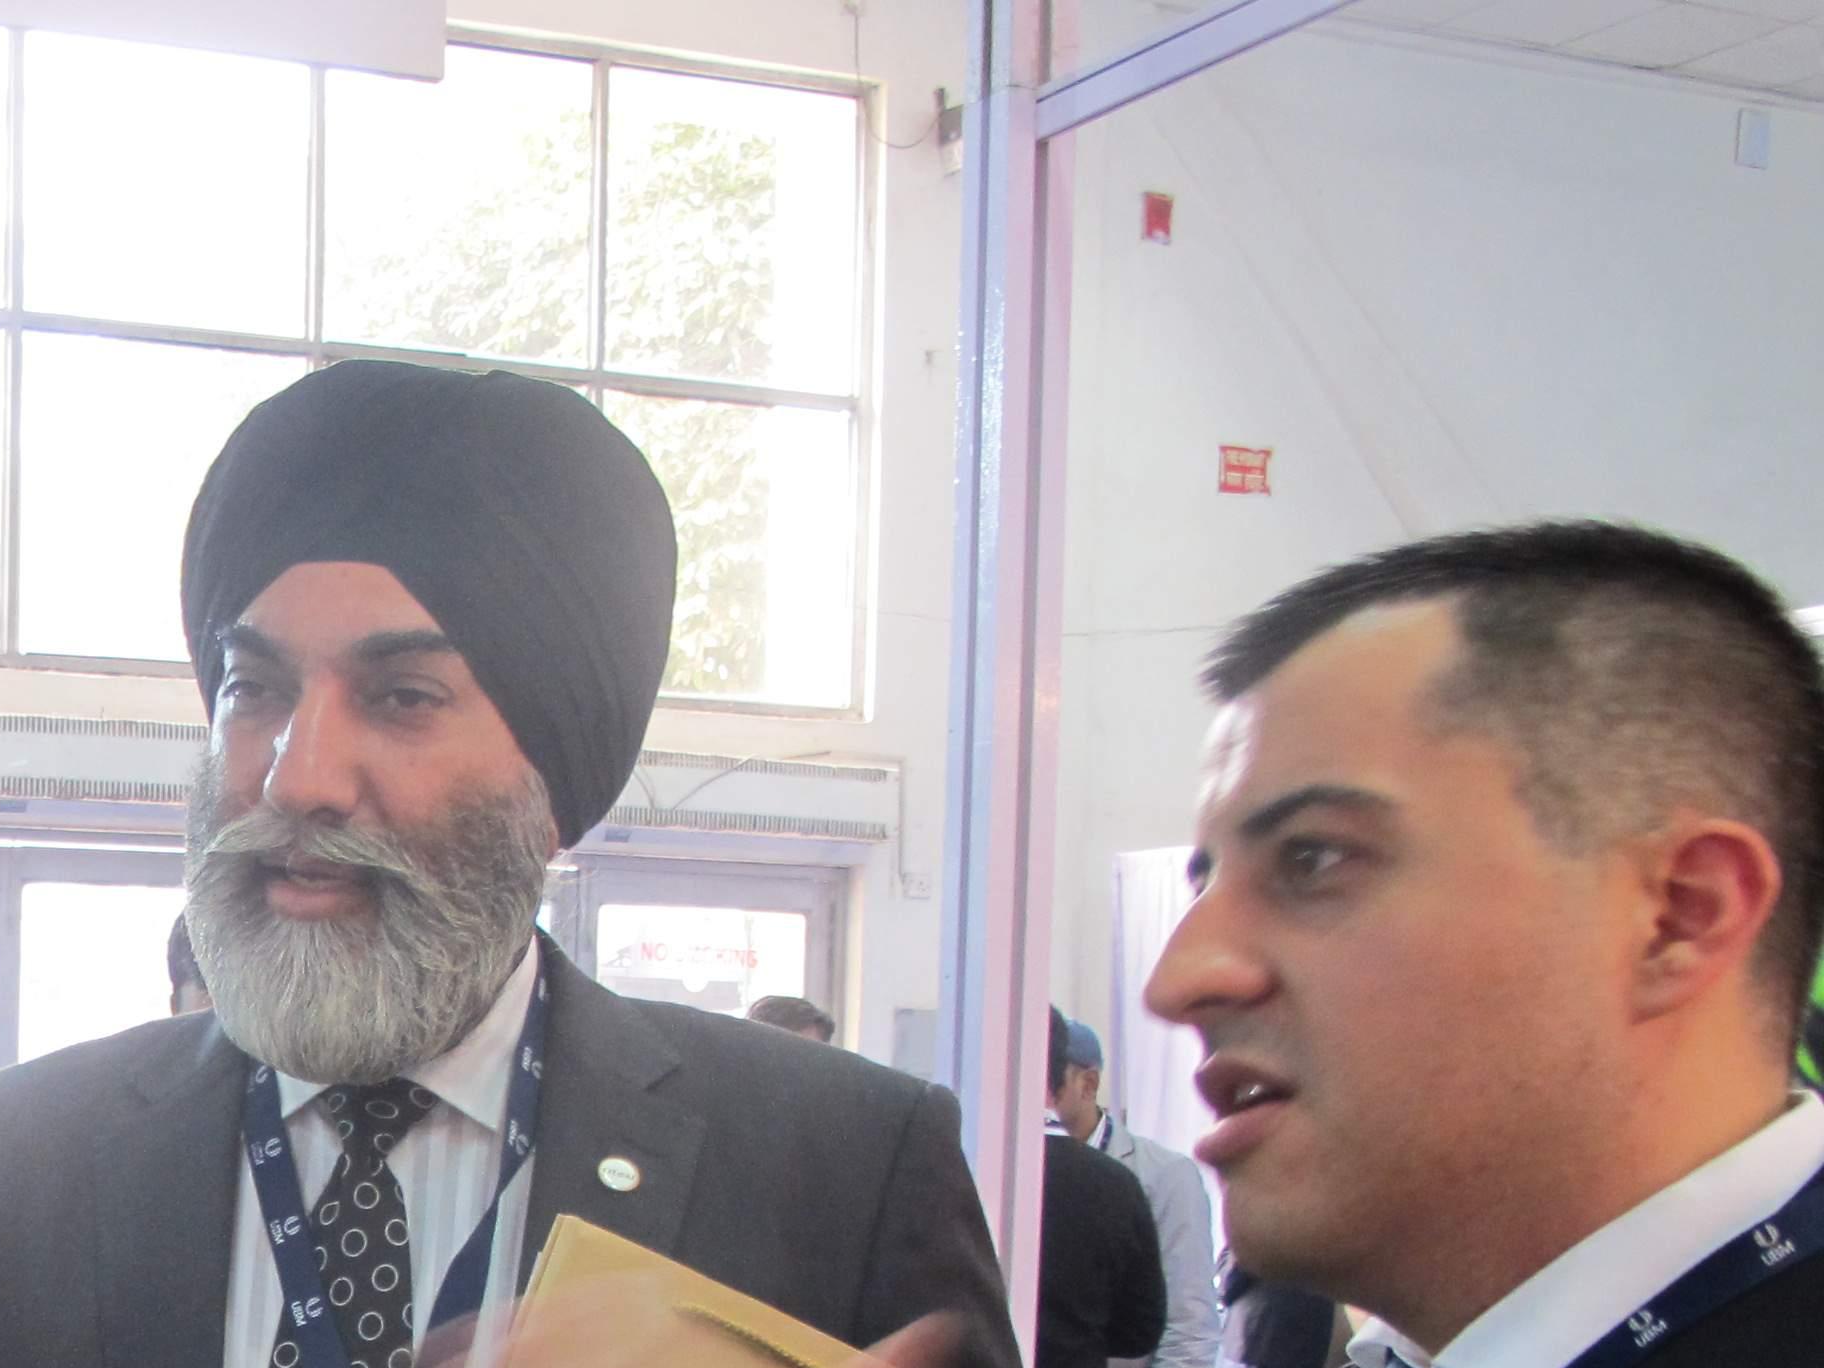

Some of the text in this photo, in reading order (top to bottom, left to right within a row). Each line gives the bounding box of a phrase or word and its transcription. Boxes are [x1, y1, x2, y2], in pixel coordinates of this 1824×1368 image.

[641, 943, 668, 962] NO
[1760, 1239, 1796, 1266] UBM
[291, 1301, 307, 1327] UBM
[1633, 1319, 1668, 1348] UBM
